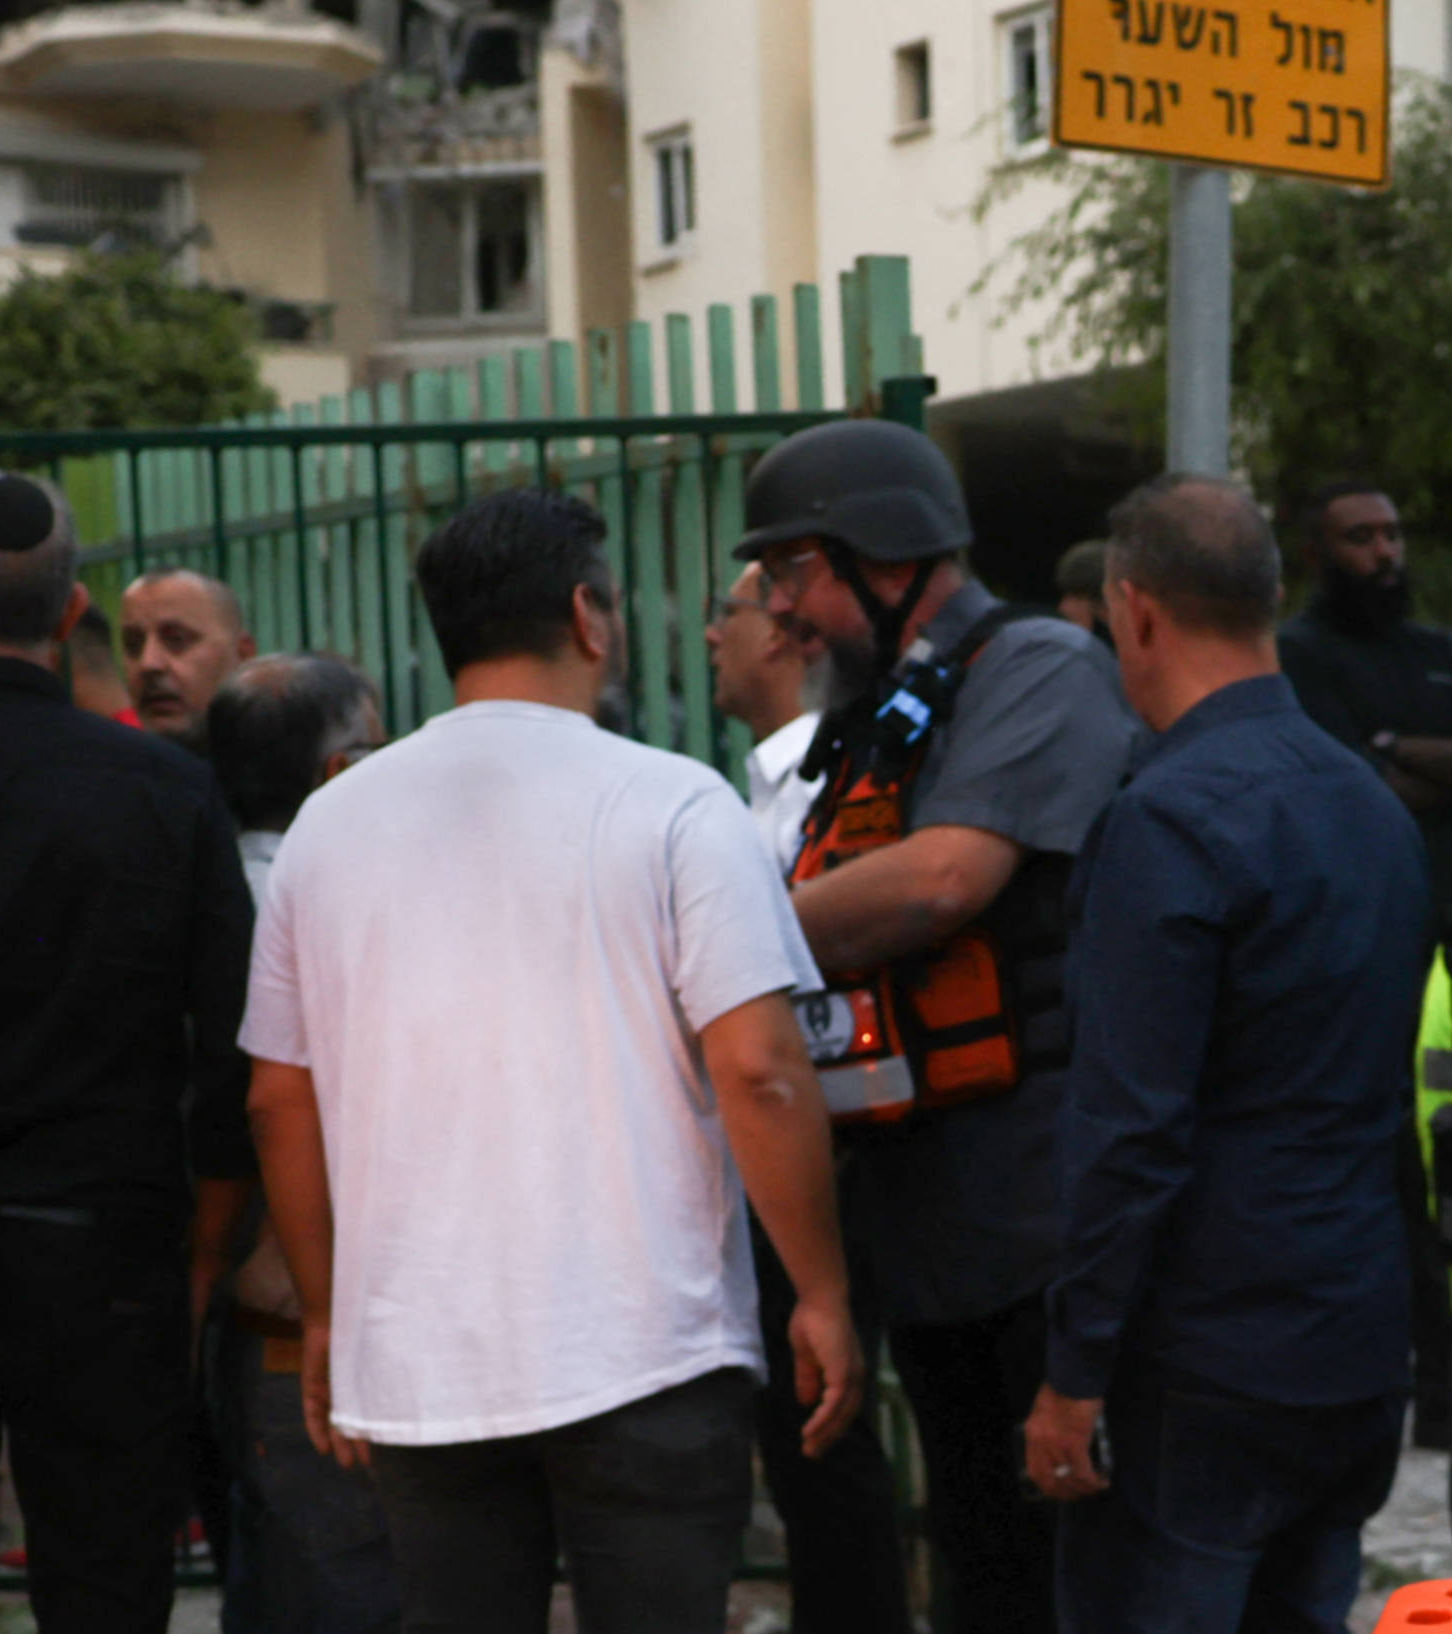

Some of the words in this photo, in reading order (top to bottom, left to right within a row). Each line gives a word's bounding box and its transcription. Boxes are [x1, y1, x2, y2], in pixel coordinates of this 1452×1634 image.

[1271, 11, 1346, 75] מול
[1081, 71, 1181, 126] יגרר
[1213, 89, 1254, 138] זר
[1287, 99, 1367, 154] רכב
